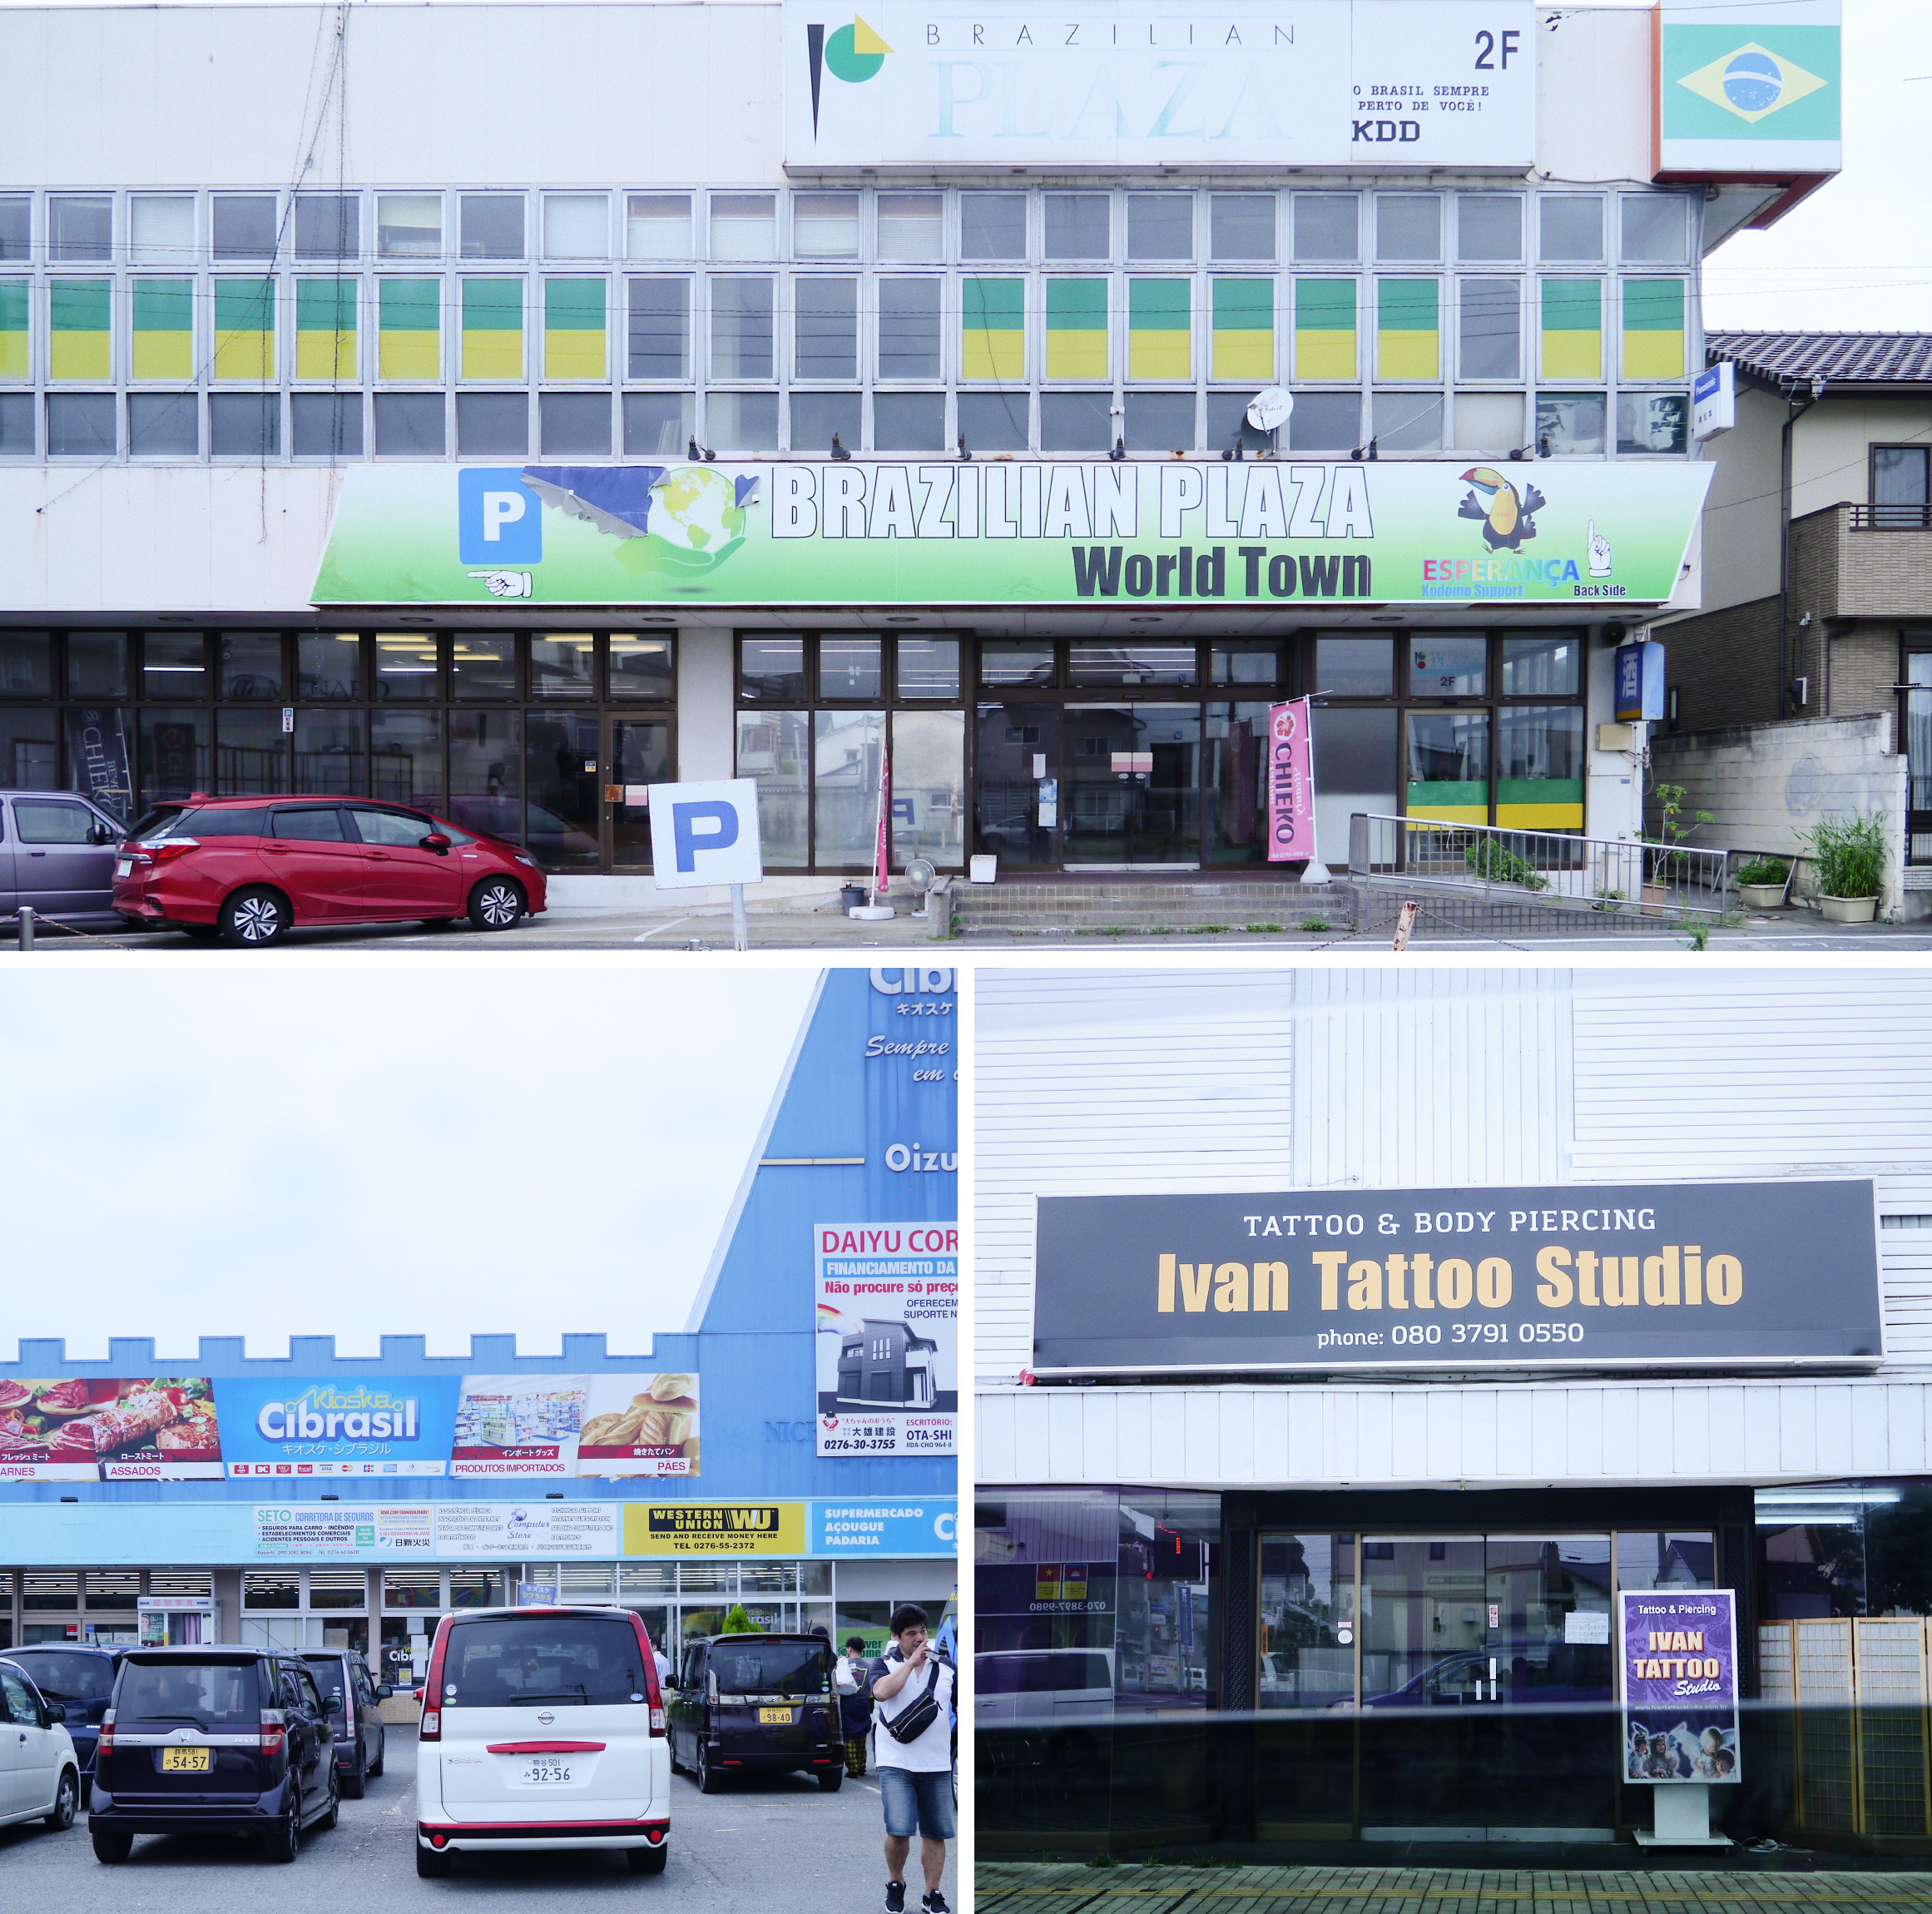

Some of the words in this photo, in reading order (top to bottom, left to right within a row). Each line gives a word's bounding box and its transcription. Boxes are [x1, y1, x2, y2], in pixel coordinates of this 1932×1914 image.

[926, 24, 1295, 46] BRAZILIAN
[1474, 29, 1521, 71] 2F
[1353, 85, 1361, 96] O
[1370, 85, 1424, 96] BRASIL
[1433, 86, 1489, 97] SEMPRE
[927, 60, 1294, 141] PLAZA
[1358, 101, 1403, 111] PERTO
[1412, 101, 1429, 111] DE
[1439, 99, 1482, 112] VOCÊ!
[1351, 120, 1420, 142] KDD
[770, 465, 1138, 539] BRAZILIAN
[1159, 465, 1375, 539] PLAZA
[483, 491, 527, 542] P
[1072, 545, 1226, 598] World
[1238, 545, 1373, 598] Town
[1423, 558, 1580, 588] ESPERANÇA
[1421, 584, 1471, 598] Kodomo
[1474, 584, 1524, 599] Support
[1573, 585, 1599, 597] Back
[1602, 585, 1627, 597] Side
[1440, 677, 1455, 687] 2F
[1622, 652, 1639, 699] 酒
[671, 800, 740, 873] P
[869, 968, 958, 994] Cib
[895, 1000, 954, 1016] キオスケ
[864, 1034, 950, 1060] Sempre
[912, 1068, 945, 1083] em
[884, 1142, 958, 1173] Oizu
[1243, 1213, 1365, 1237] TATTOO
[1377, 1212, 1401, 1236] &
[1414, 1211, 1496, 1233] BODY
[1510, 1208, 1657, 1232] PIERCING
[821, 1230, 902, 1253] DAIYU
[908, 1229, 958, 1252] COR
[826, 1261, 934, 1276] FINANCIAMENTO
[936, 1261, 956, 1275] DA
[1157, 1252, 1290, 1313] Ivan
[1311, 1250, 1513, 1312] Tattoo
[1534, 1245, 1744, 1309] Studio
[825, 1281, 850, 1294] Não
[853, 1282, 904, 1296] procure
[907, 1280, 924, 1293] só
[906, 1299, 958, 1308] OFERECEM
[904, 1310, 948, 1319] SUPORTE
[1316, 1329, 1385, 1350] phone:
[1390, 1324, 1442, 1346] 080
[1450, 1323, 1508, 1345] 3791
[1518, 1321, 1585, 1344] 0550
[258, 1399, 416, 1439] Cibrasil
[906, 1417, 953, 1426] ESCRITÓRIO:
[852, 1426, 897, 1437] 大雄建設
[906, 1430, 953, 1440] OTA-SHI
[282, 1442, 392, 1455] キオスケ・シブラジル
[632, 1447, 676, 1455] 焼きたてパン
[824, 1439, 896, 1450] 0276-30-3755
[121, 1452, 165, 1460] ローストミート
[0, 1467, 36, 1477] ARNES
[110, 1466, 161, 1475] ASSADOS
[455, 1464, 506, 1473] PRODUTOS
[506, 1464, 566, 1472] IMPORTADOS
[657, 1460, 686, 1471] PÃES
[257, 1509, 292, 1523] SETO
[295, 1512, 334, 1522] CORRETORA
[334, 1512, 344, 1521] DE
[345, 1512, 374, 1522] SEGUROS
[652, 1510, 723, 1520] WESTERN
[730, 1510, 773, 1530] WU
[825, 1508, 924, 1519] SUPERMERCADO
[507, 1520, 550, 1530] Computer
[675, 1520, 723, 1530] UNION
[825, 1521, 884, 1533] AÇOUGUE
[507, 1531, 532, 1540] Store
[825, 1535, 879, 1545] PADARIA
[395, 1538, 430, 1547] 日新火災
[1637, 1604, 1667, 1615] Tattoo
[1669, 1604, 1677, 1614] &
[1678, 1604, 1717, 1616] Piercing
[1648, 1631, 1704, 1652] IVAN
[1633, 1658, 1720, 1679] TATTOO
[1673, 1678, 1721, 1697] Studio
[766, 1713, 790, 1722] 98-40
[173, 1756, 206, 1768] 54-57
[533, 1758, 547, 1767] 熊谷
[548, 1758, 561, 1767] 501
[532, 1768, 571, 1782] 92-56
